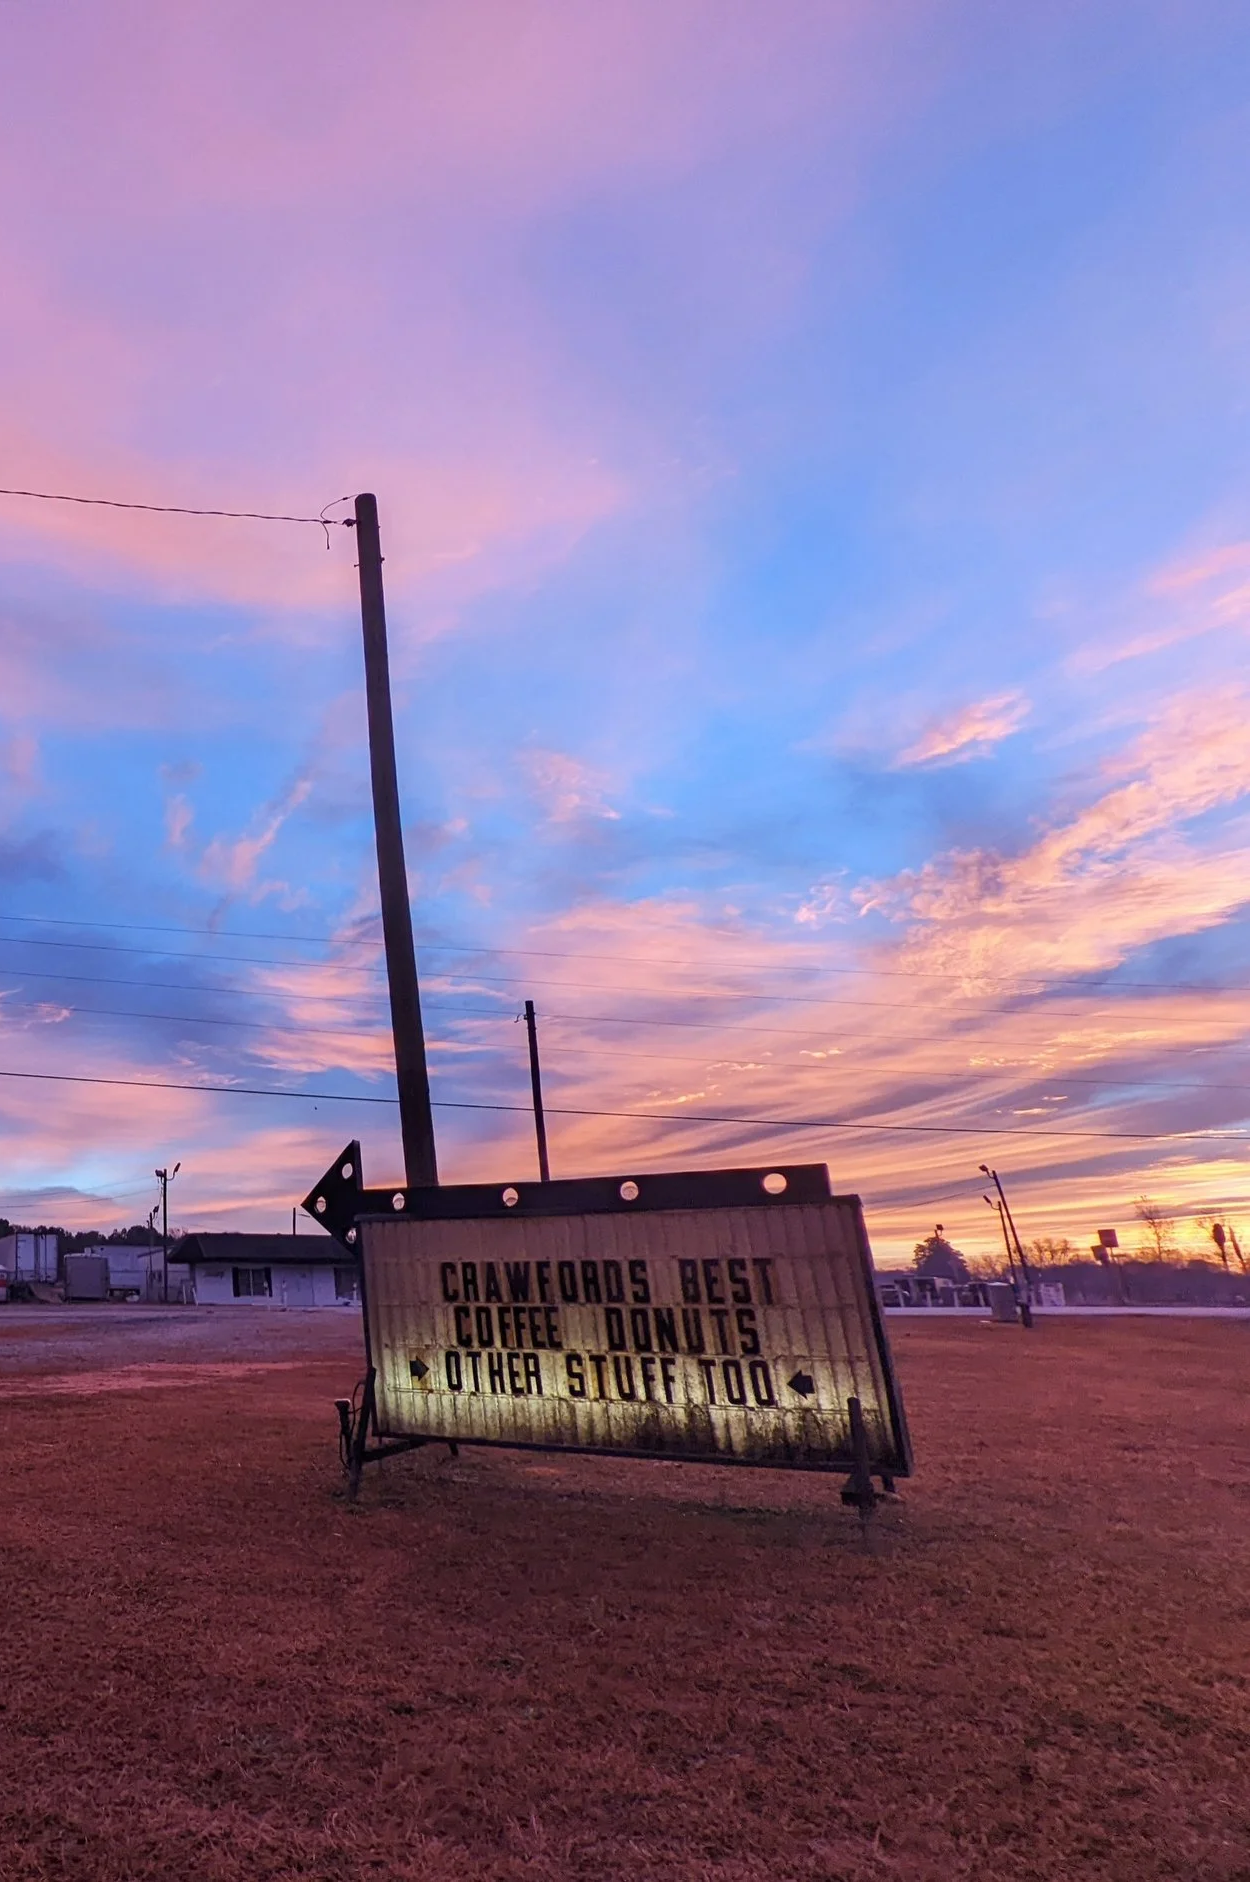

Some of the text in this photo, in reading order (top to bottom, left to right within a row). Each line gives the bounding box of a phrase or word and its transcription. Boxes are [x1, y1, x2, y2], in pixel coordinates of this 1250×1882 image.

[441, 1258, 773, 1305] CRAWFORDS BEST
[454, 1306, 761, 1355] COFFEE DONUTS
[445, 1351, 775, 1406] OTHER STUFF TOO
